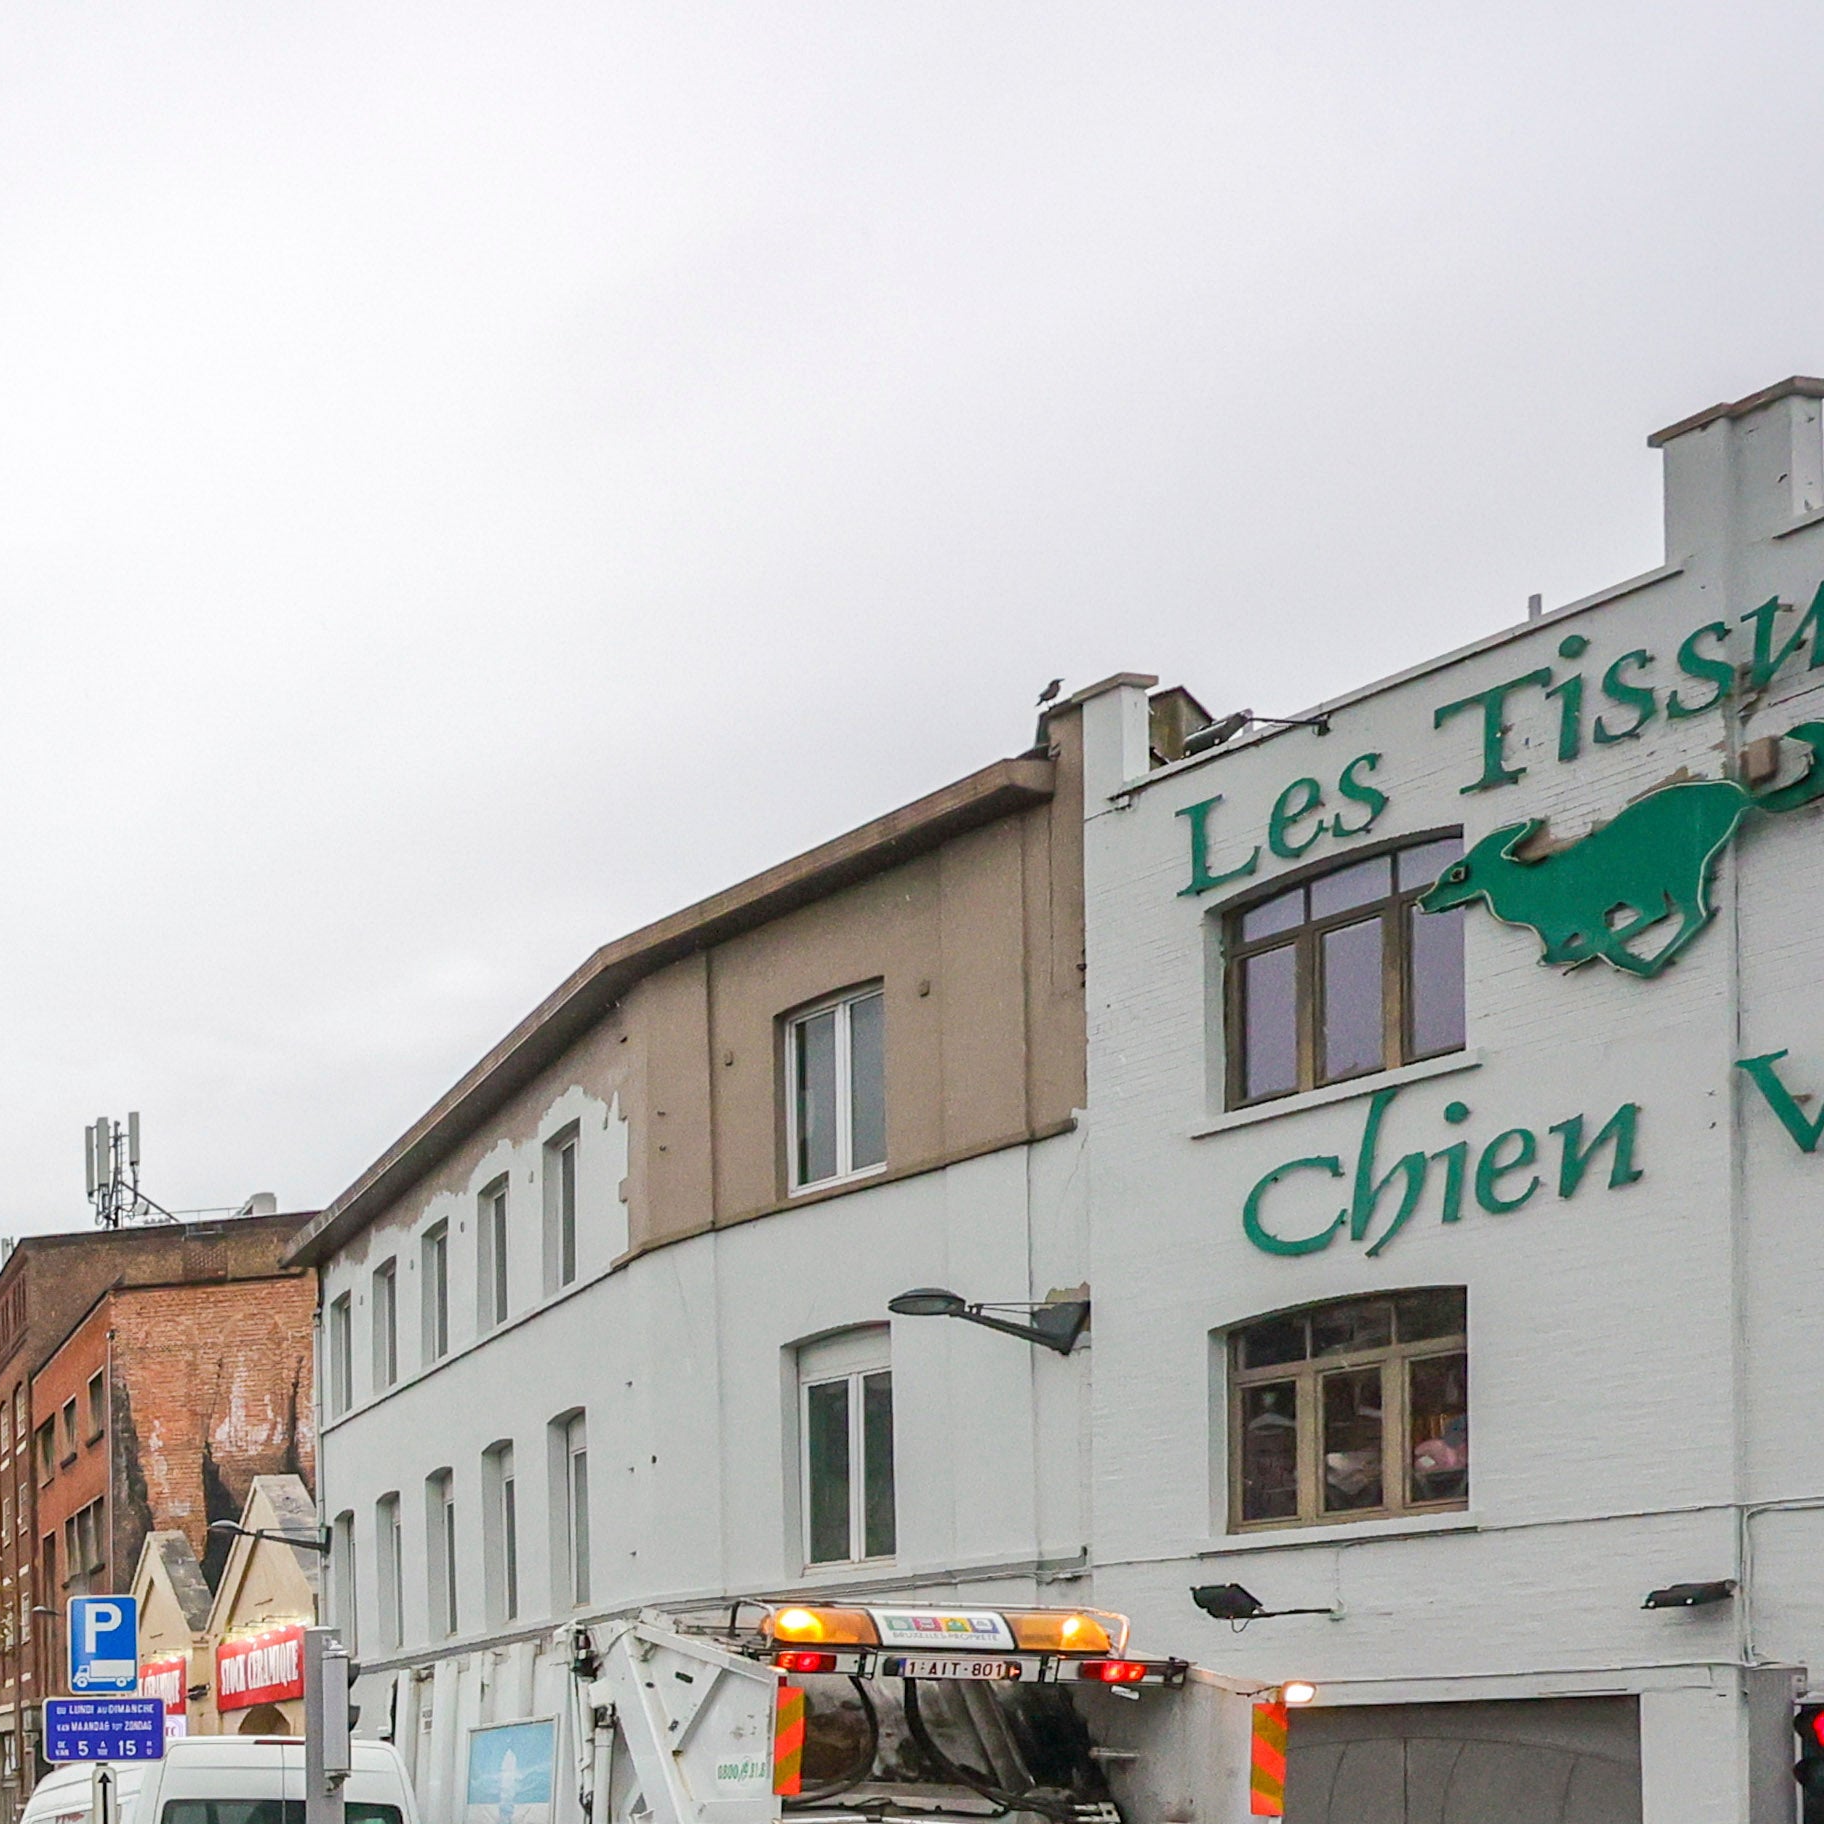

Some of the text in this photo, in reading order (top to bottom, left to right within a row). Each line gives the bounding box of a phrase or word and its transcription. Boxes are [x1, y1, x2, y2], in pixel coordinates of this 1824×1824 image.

[1175, 752, 1389, 898] Les
[1242, 1090, 1643, 1258] Chien
[85, 1603, 122, 1653] P
[221, 1640, 299, 1696] STOCK CÉRAMIQUE
[56, 1703, 155, 1715] DU LUNDI AU DIMANCHE
[71, 1721, 110, 1731] MAANDAG
[124, 1720, 152, 1731] ZONDAG
[77, 1740, 90, 1756] 5
[118, 1740, 137, 1756] 15
